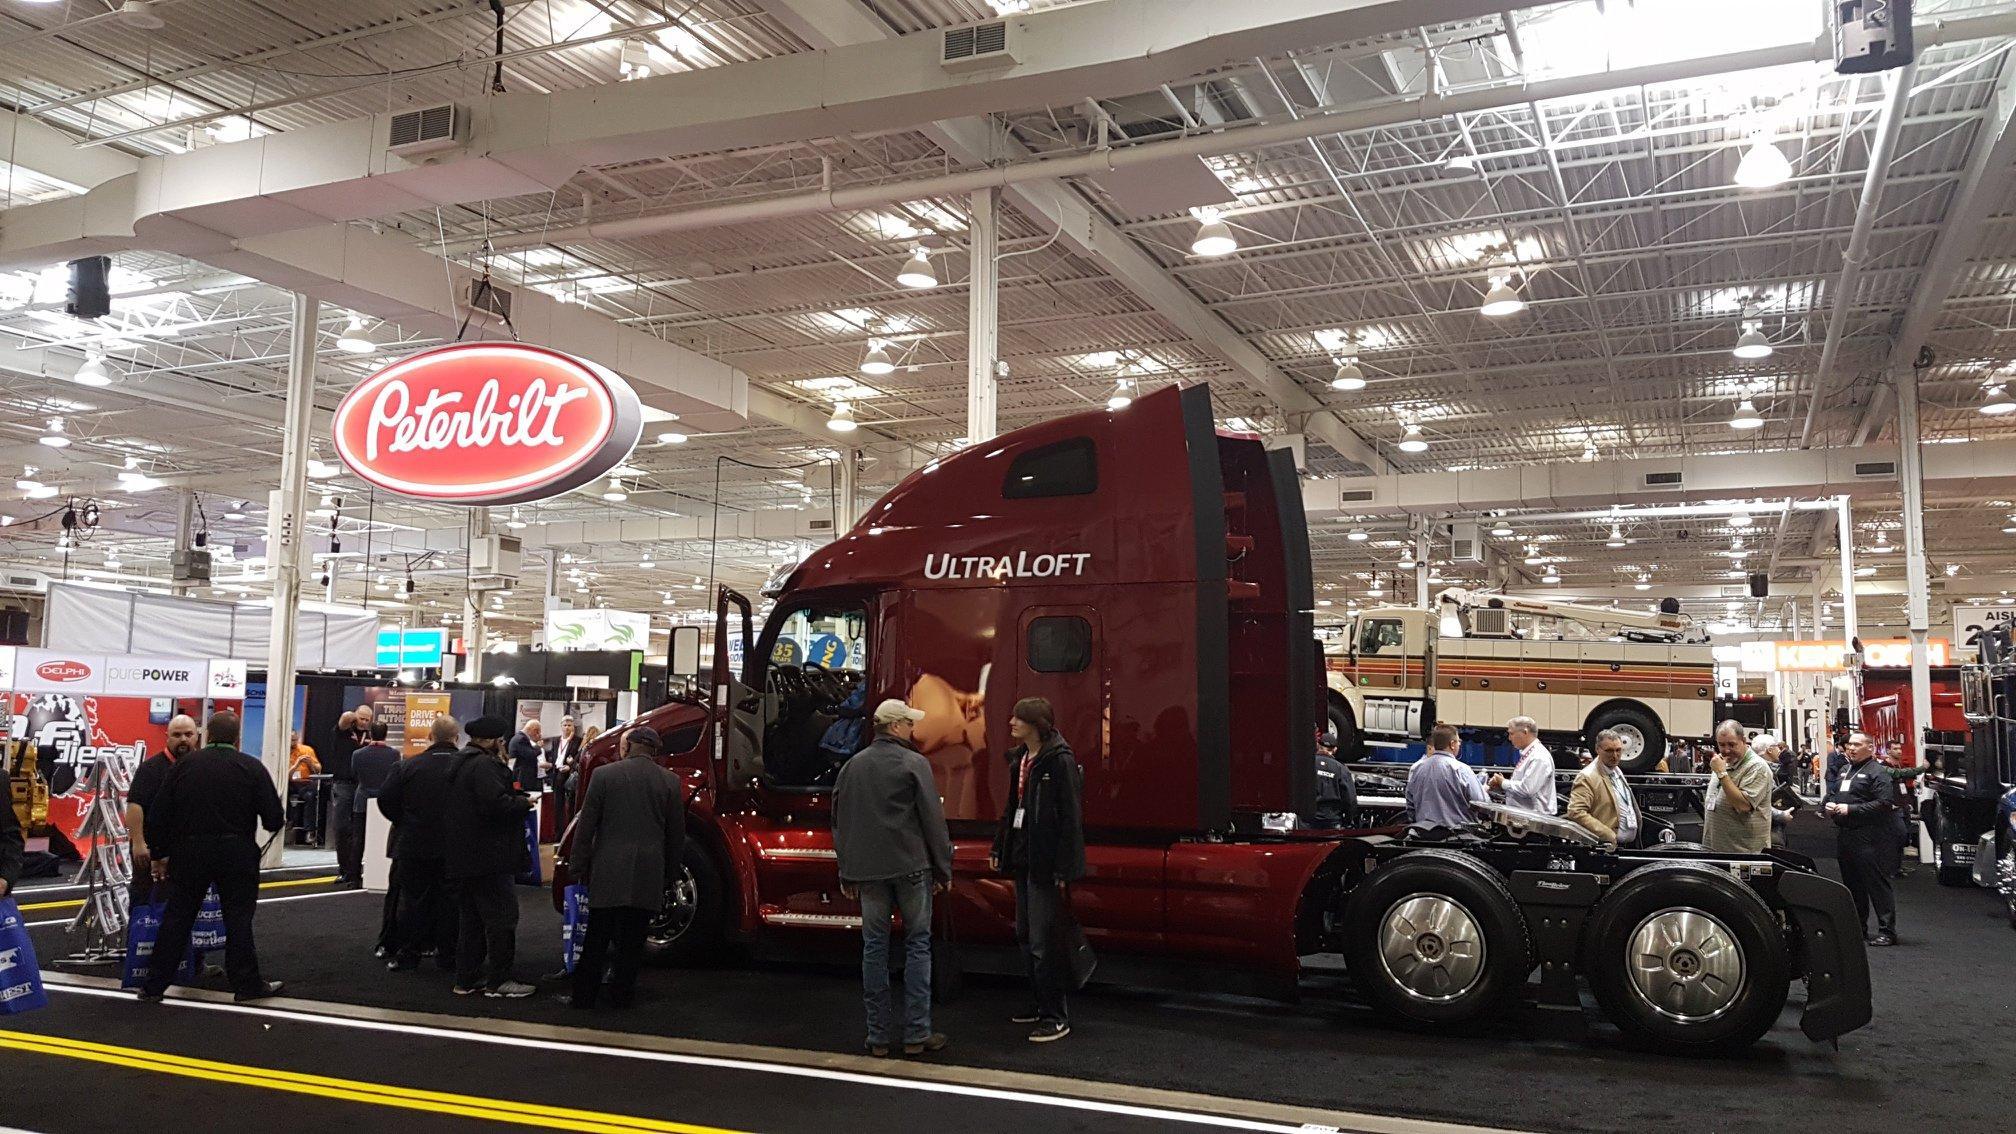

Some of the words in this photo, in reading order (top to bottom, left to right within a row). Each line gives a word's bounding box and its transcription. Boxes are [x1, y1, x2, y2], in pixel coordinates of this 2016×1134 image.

[366, 377, 589, 462] Peterbilt
[41, 667, 86, 676] DELPHI
[410, 710, 435, 719] DRIVE
